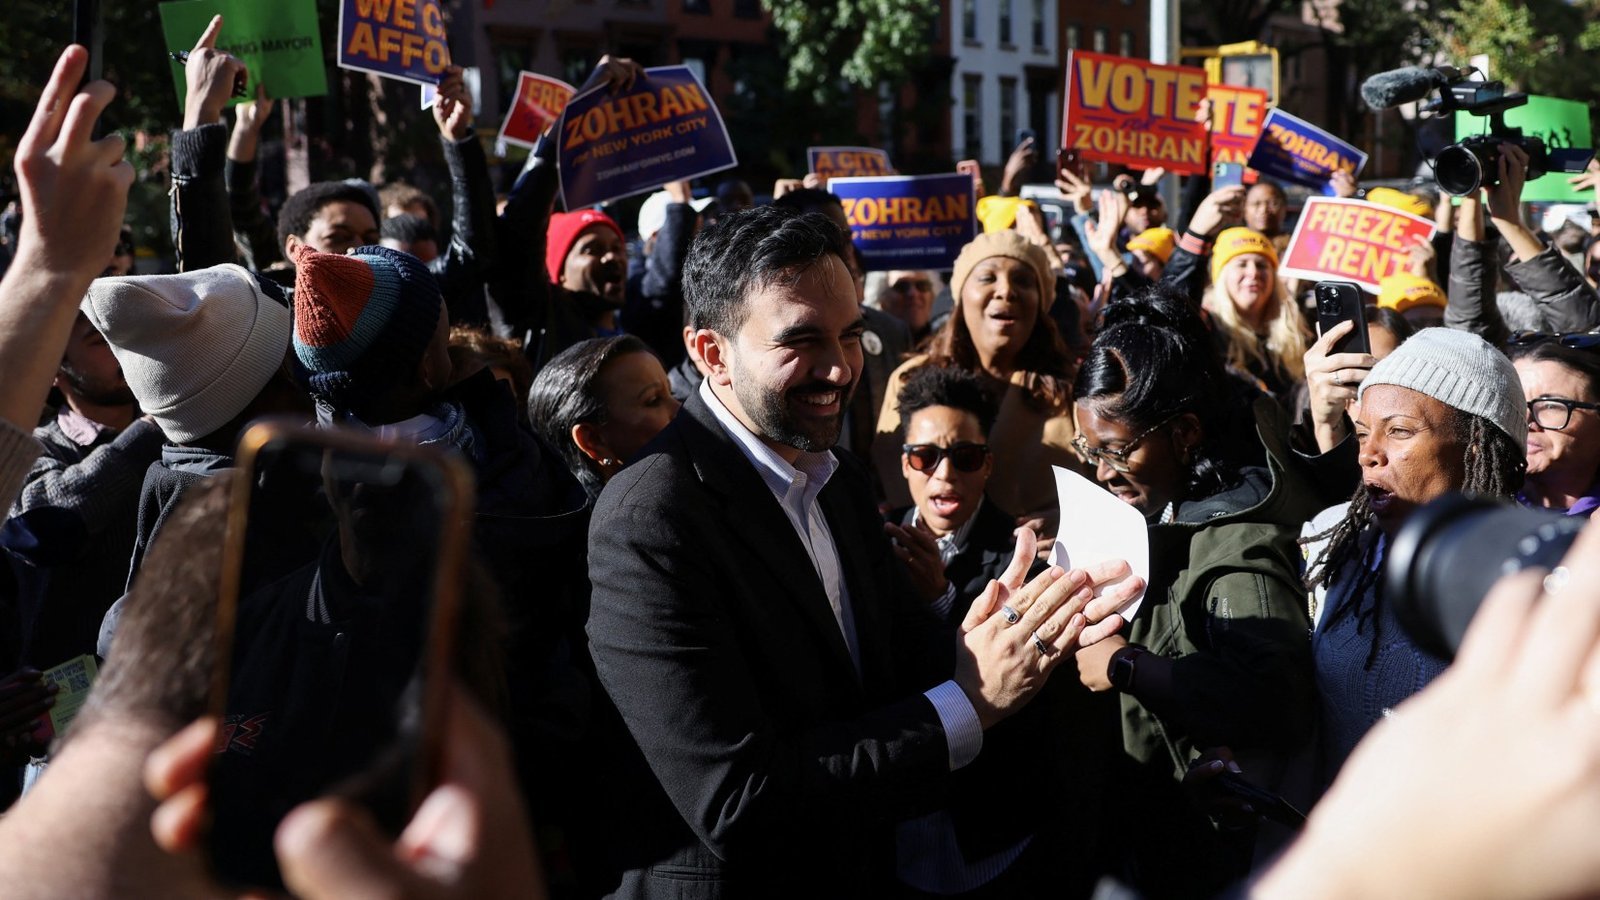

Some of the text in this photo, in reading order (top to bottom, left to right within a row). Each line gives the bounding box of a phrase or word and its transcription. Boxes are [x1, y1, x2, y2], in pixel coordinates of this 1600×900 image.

[354, 0, 446, 39] WE C
[1076, 57, 1205, 121] VOTE
[566, 83, 707, 149] ZOHRAN
[1207, 88, 1264, 136] TE
[592, 138, 628, 157] NEW
[631, 125, 673, 147] YORK
[676, 117, 707, 134] CITY
[1073, 123, 1203, 164] ZOHRAN
[1268, 123, 1355, 174] ZOHRAN
[816, 152, 886, 169] A CITY
[841, 194, 968, 226] ZOHRAN
[1308, 203, 1410, 248] FREEZE
[861, 229, 894, 241] NEW
[895, 227, 930, 240] YORK
[932, 225, 963, 237] CITY
[1317, 236, 1412, 283] RENT
